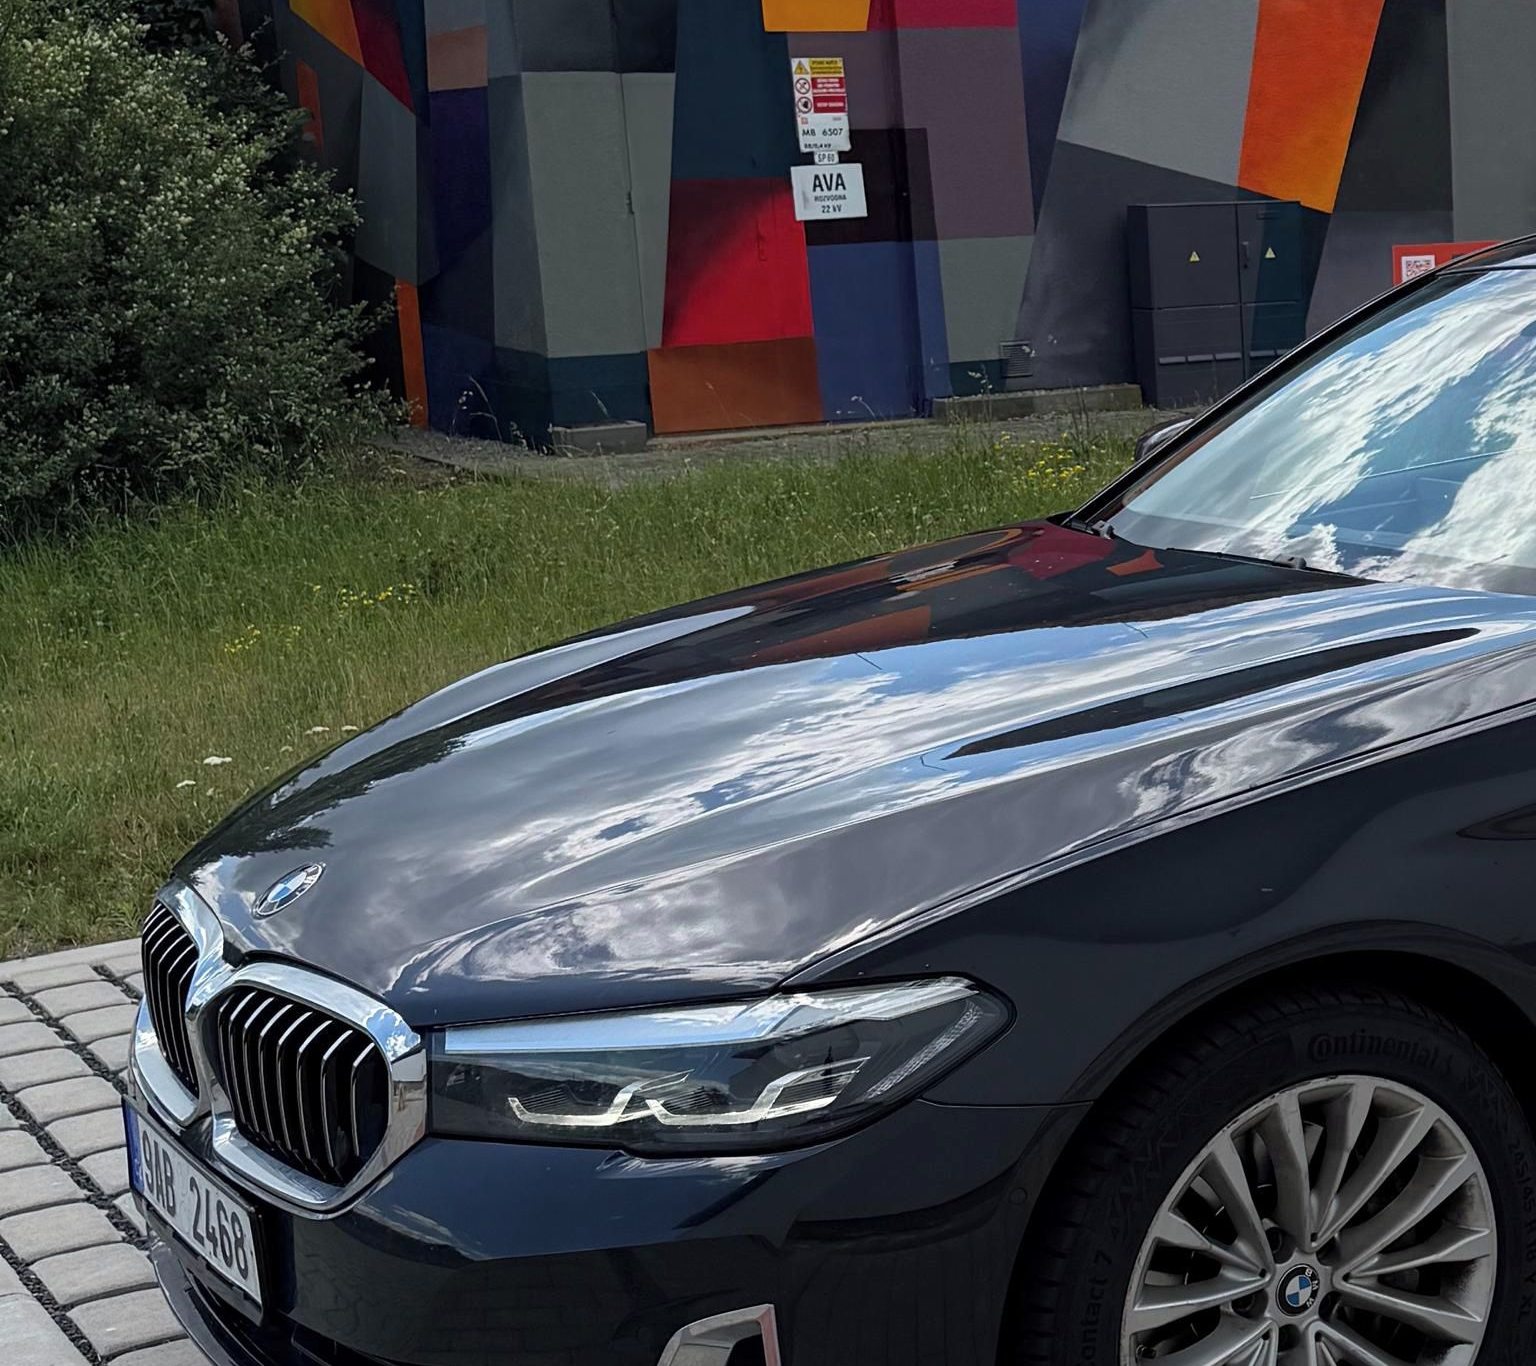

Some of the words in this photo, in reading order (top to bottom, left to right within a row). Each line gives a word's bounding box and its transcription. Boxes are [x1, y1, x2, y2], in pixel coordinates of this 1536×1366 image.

[802, 128, 816, 137] MB
[822, 128, 843, 136] 6507
[812, 173, 847, 192] AVA
[821, 205, 830, 213] 22
[1308, 1028, 1439, 1069] Continental
[142, 1130, 177, 1218] 9AB
[190, 1176, 249, 1280] 2468
